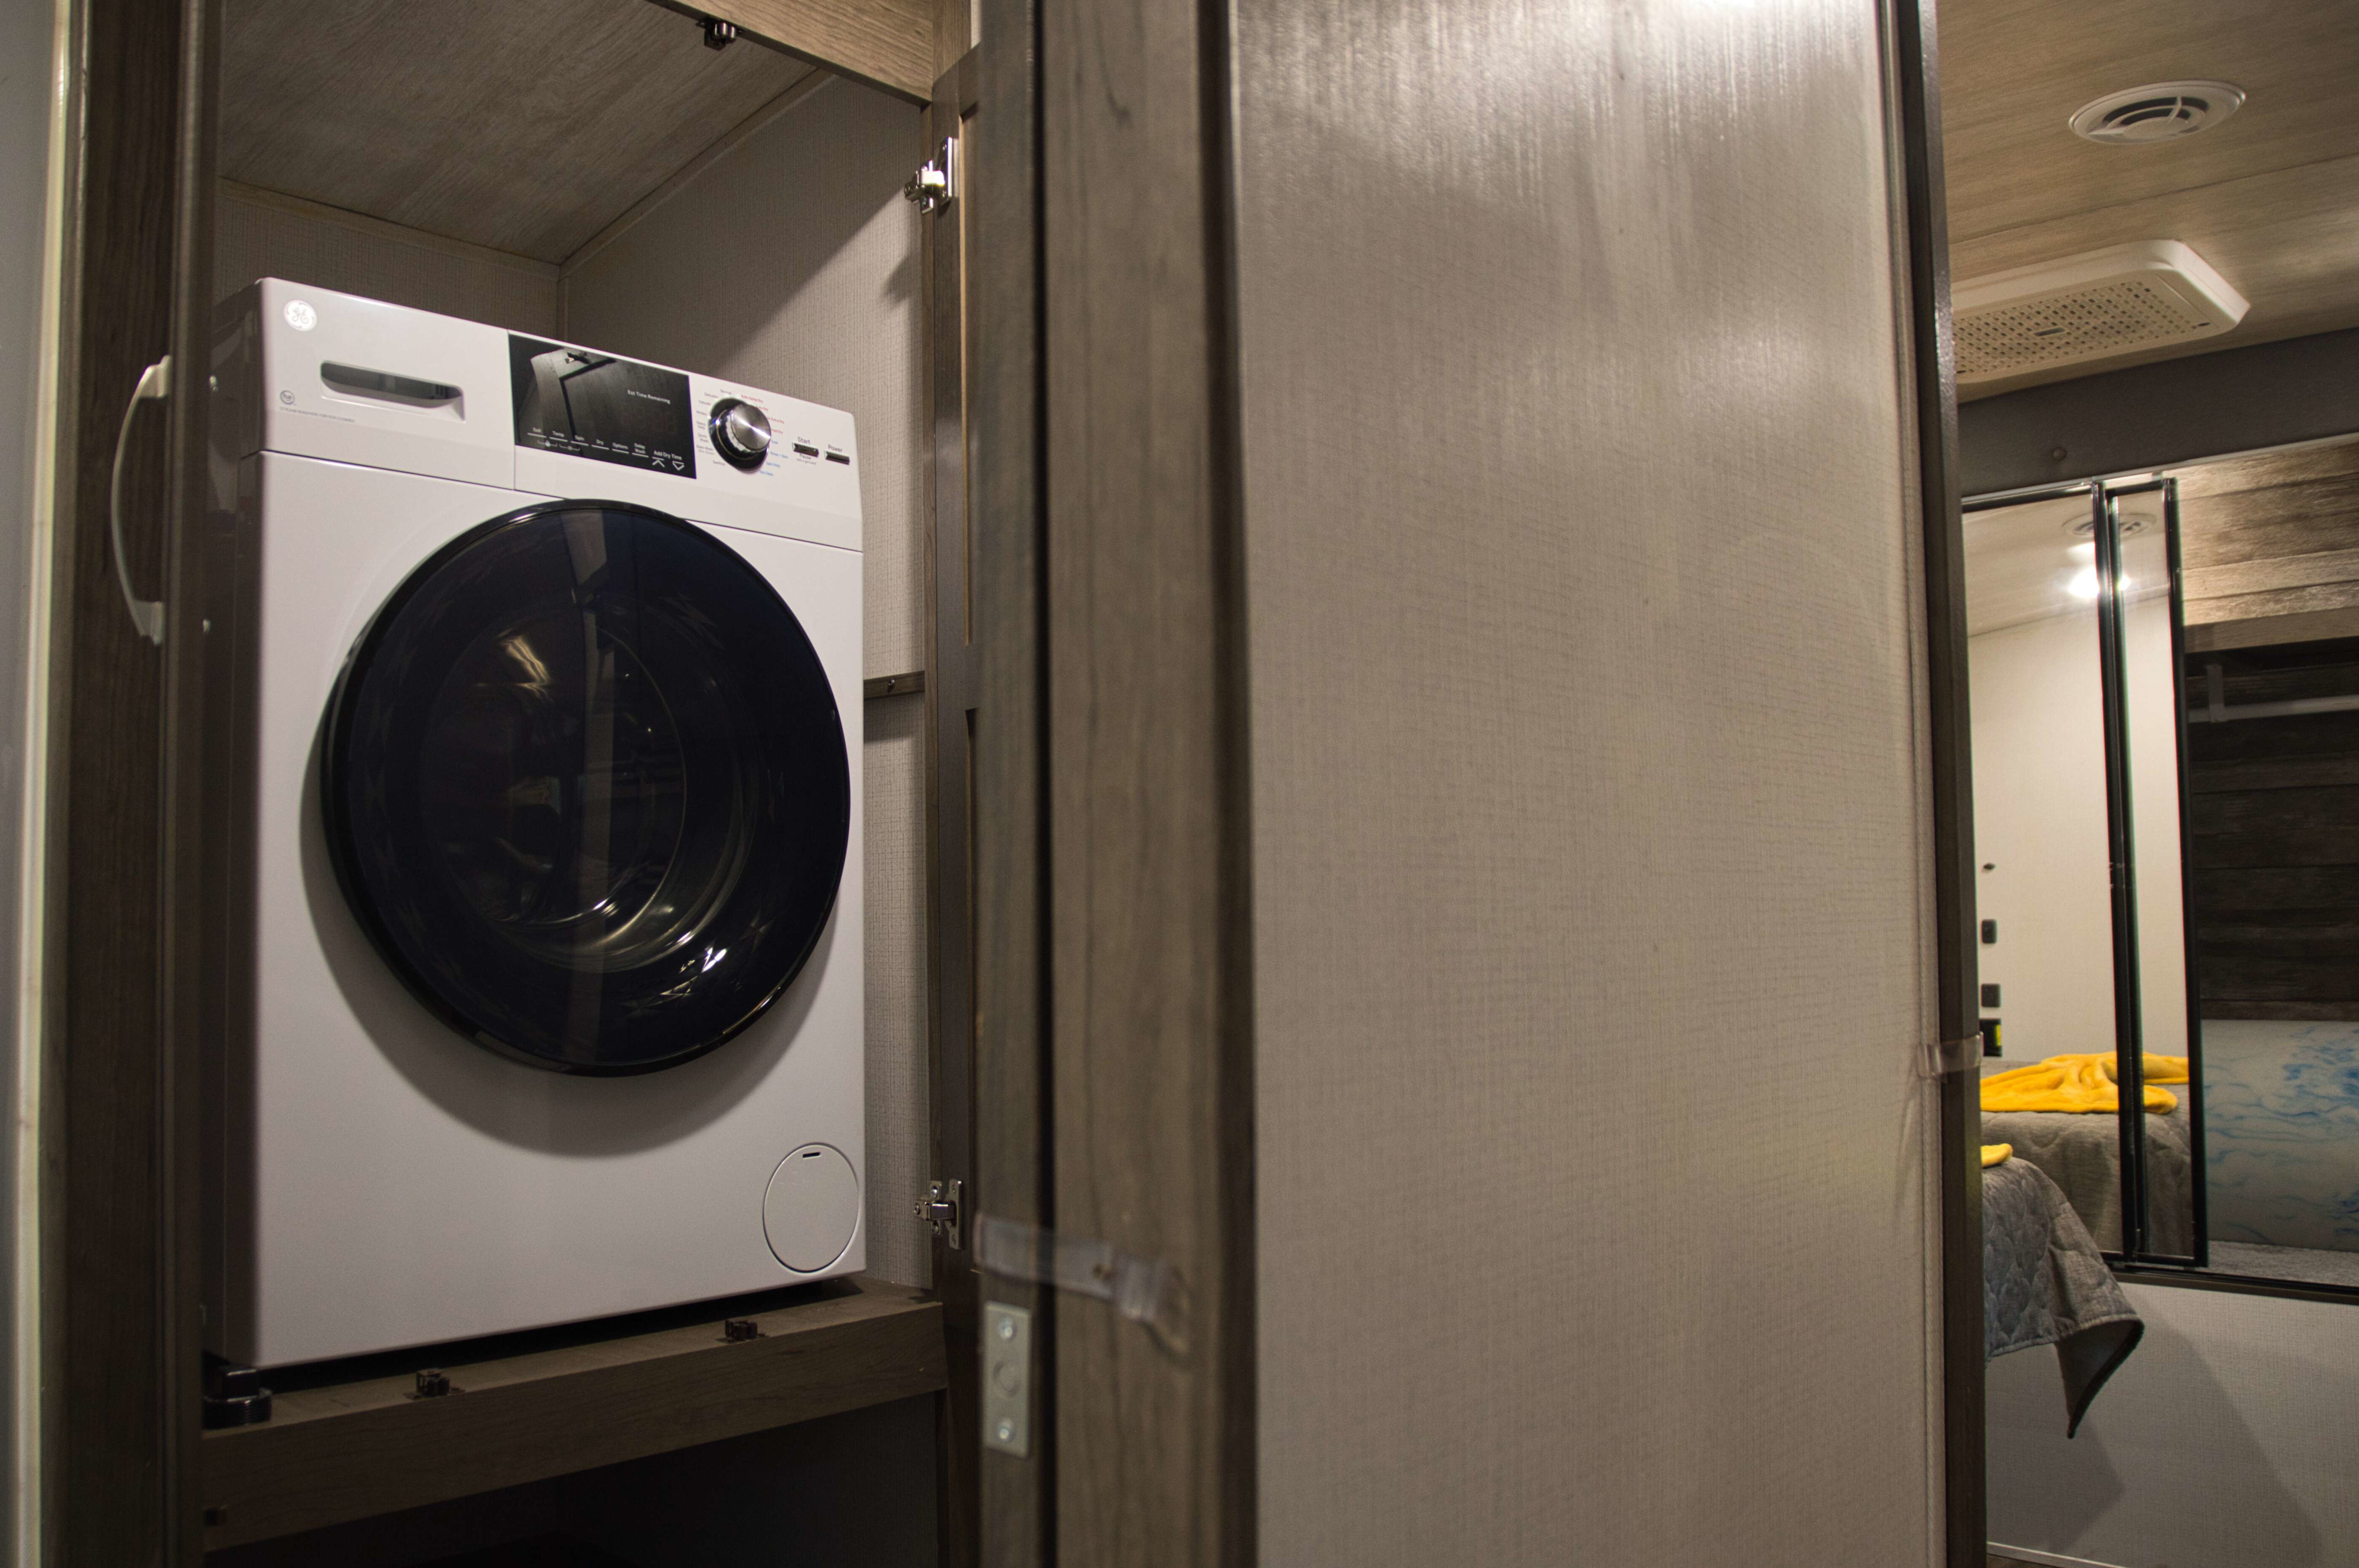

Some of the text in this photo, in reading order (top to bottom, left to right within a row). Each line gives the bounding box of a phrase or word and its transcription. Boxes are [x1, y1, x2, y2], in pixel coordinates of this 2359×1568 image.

[648, 394, 671, 405] Remaining
[797, 436, 810, 445] Start
[828, 444, 843, 452] Power
